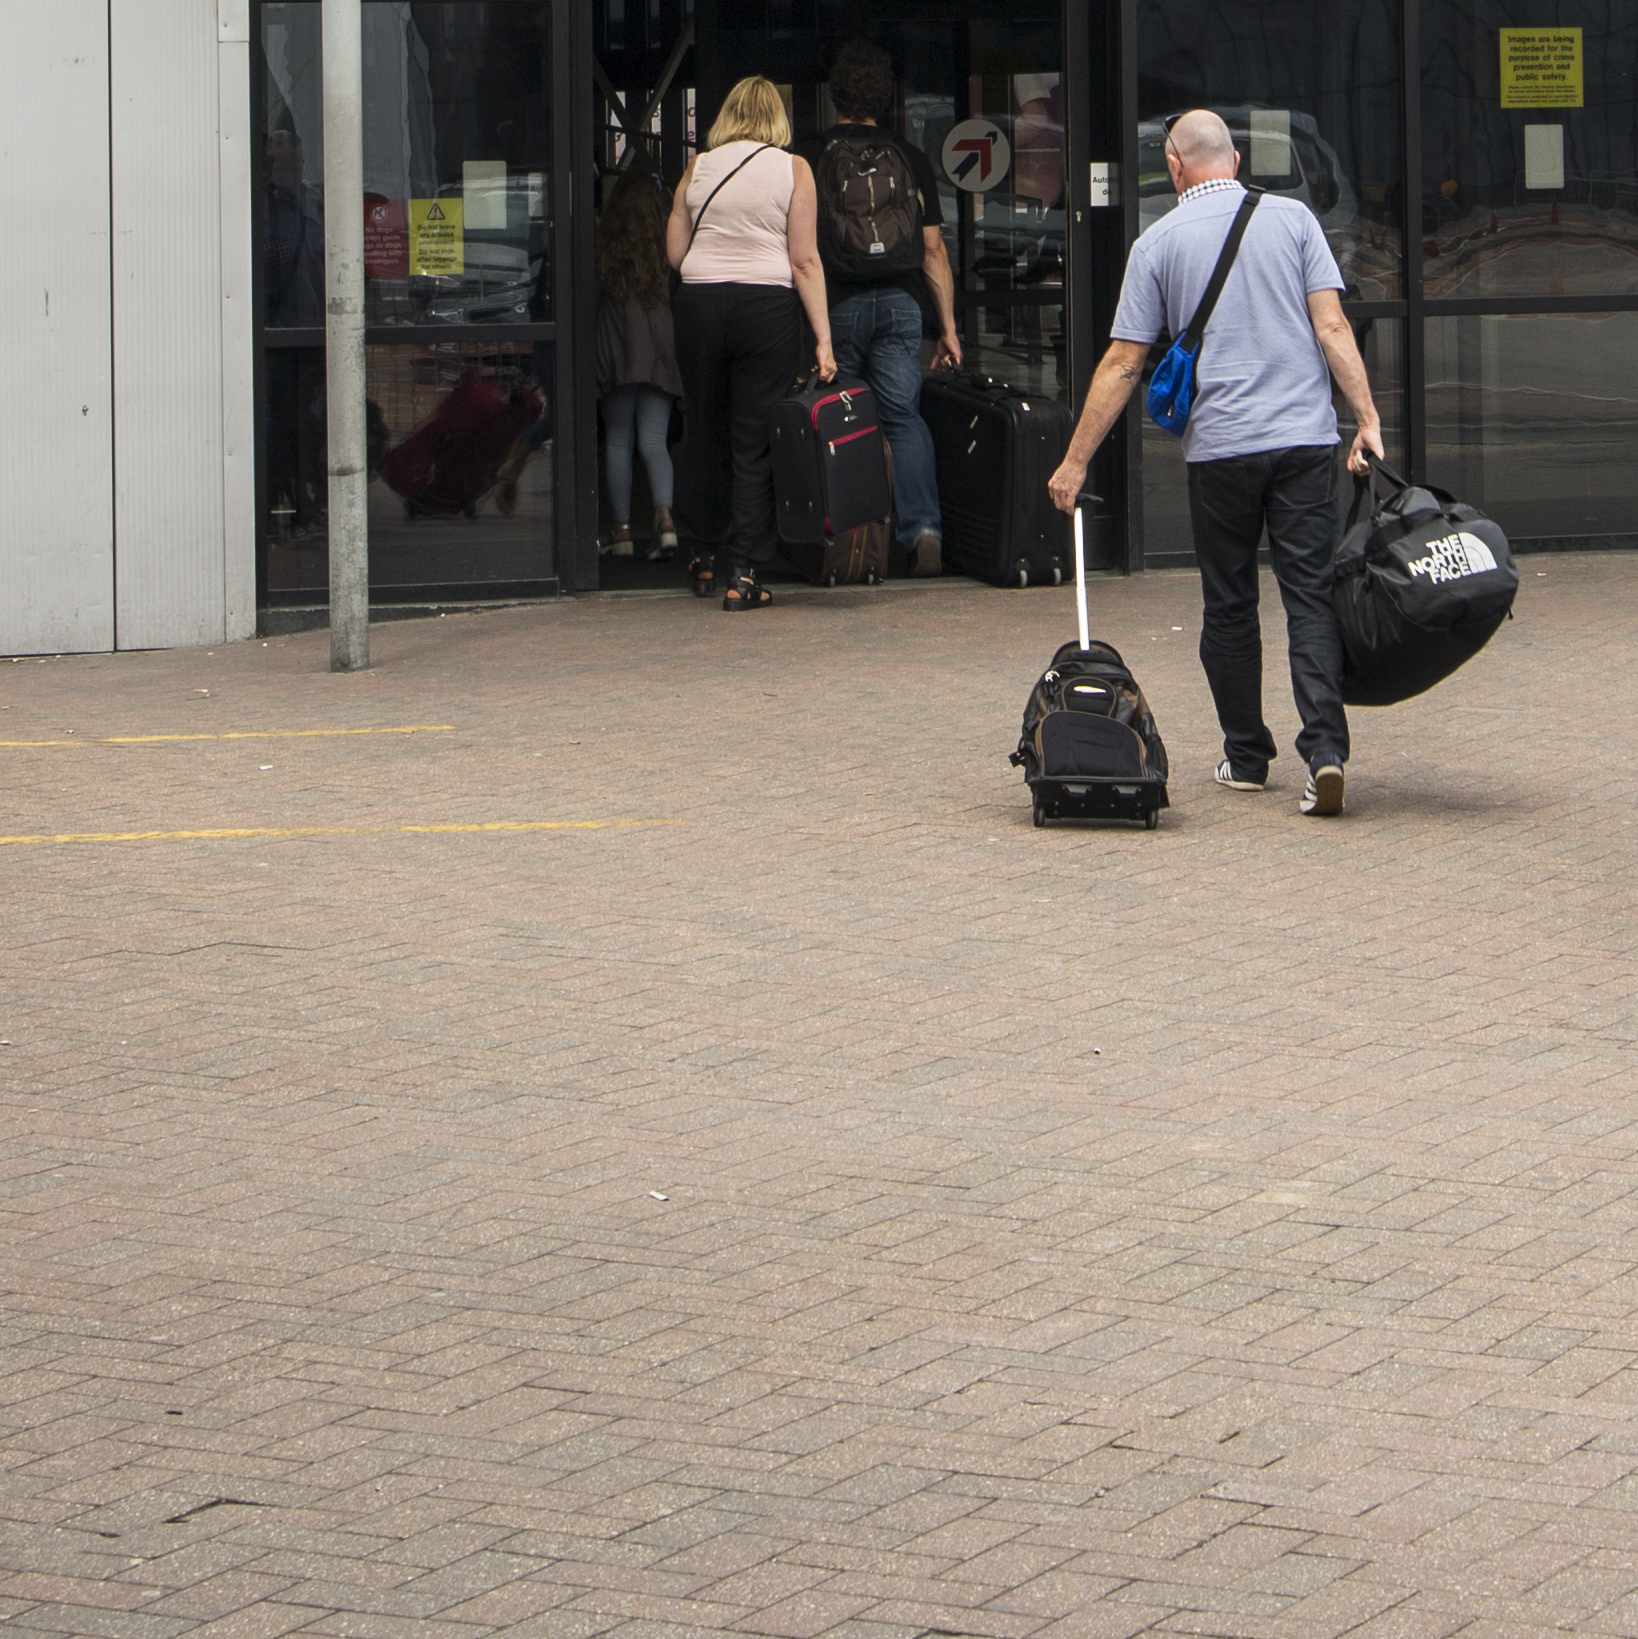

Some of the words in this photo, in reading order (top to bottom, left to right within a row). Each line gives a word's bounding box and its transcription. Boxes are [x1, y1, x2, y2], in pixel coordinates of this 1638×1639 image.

[1508, 36, 1536, 44] Images
[1554, 36, 1574, 44] being
[1508, 54, 1540, 63] purpose
[1513, 63, 1553, 72] prevention
[1516, 73, 1539, 81] public
[1425, 534, 1462, 555] THE
[1408, 547, 1468, 577] NORTH
[1429, 562, 1472, 585] FACE
